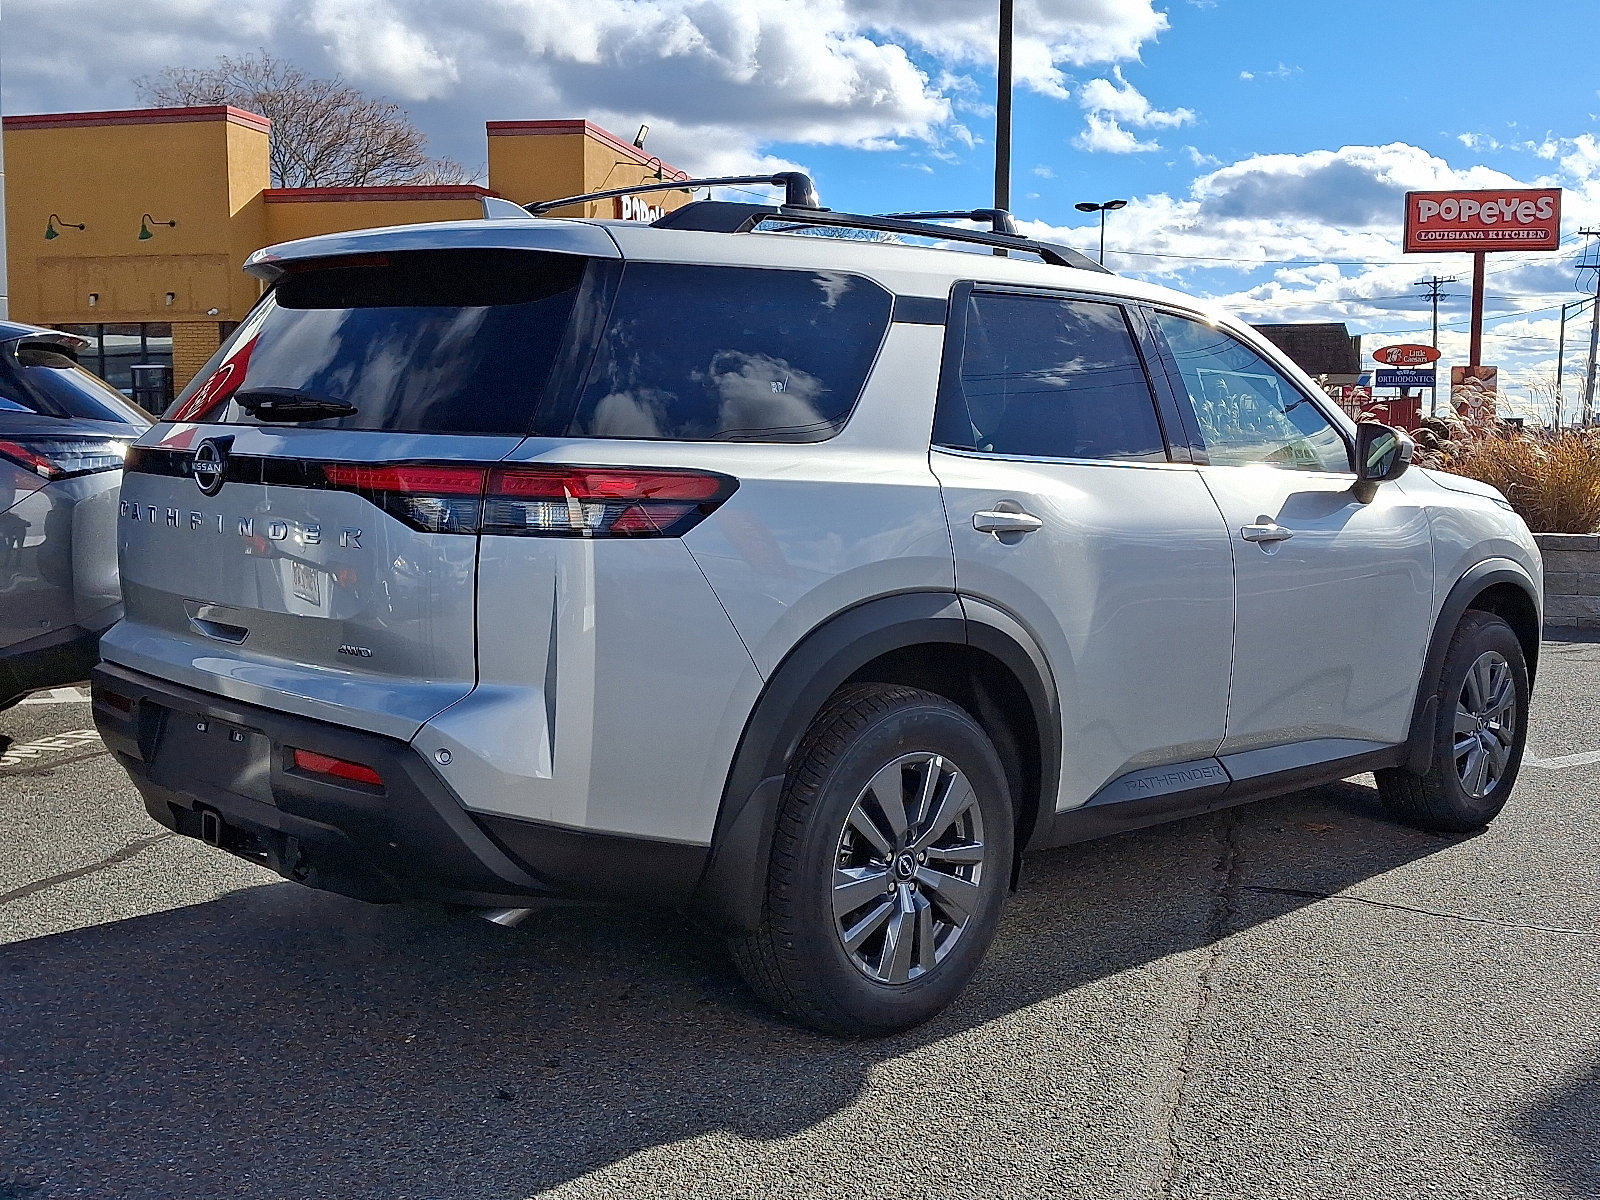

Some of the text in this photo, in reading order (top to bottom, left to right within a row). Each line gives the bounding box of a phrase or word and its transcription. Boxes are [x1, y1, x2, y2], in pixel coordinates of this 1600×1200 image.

[1420, 230, 1546, 240] LOUISIANA KITCHEN
[1403, 355, 1428, 363] Caesars
[1377, 375, 1435, 383] ORTHODONTICS
[120, 500, 362, 549] PATHFINDER
[338, 643, 373, 657] 4WD
[1124, 765, 1222, 790] PATHFINDER
